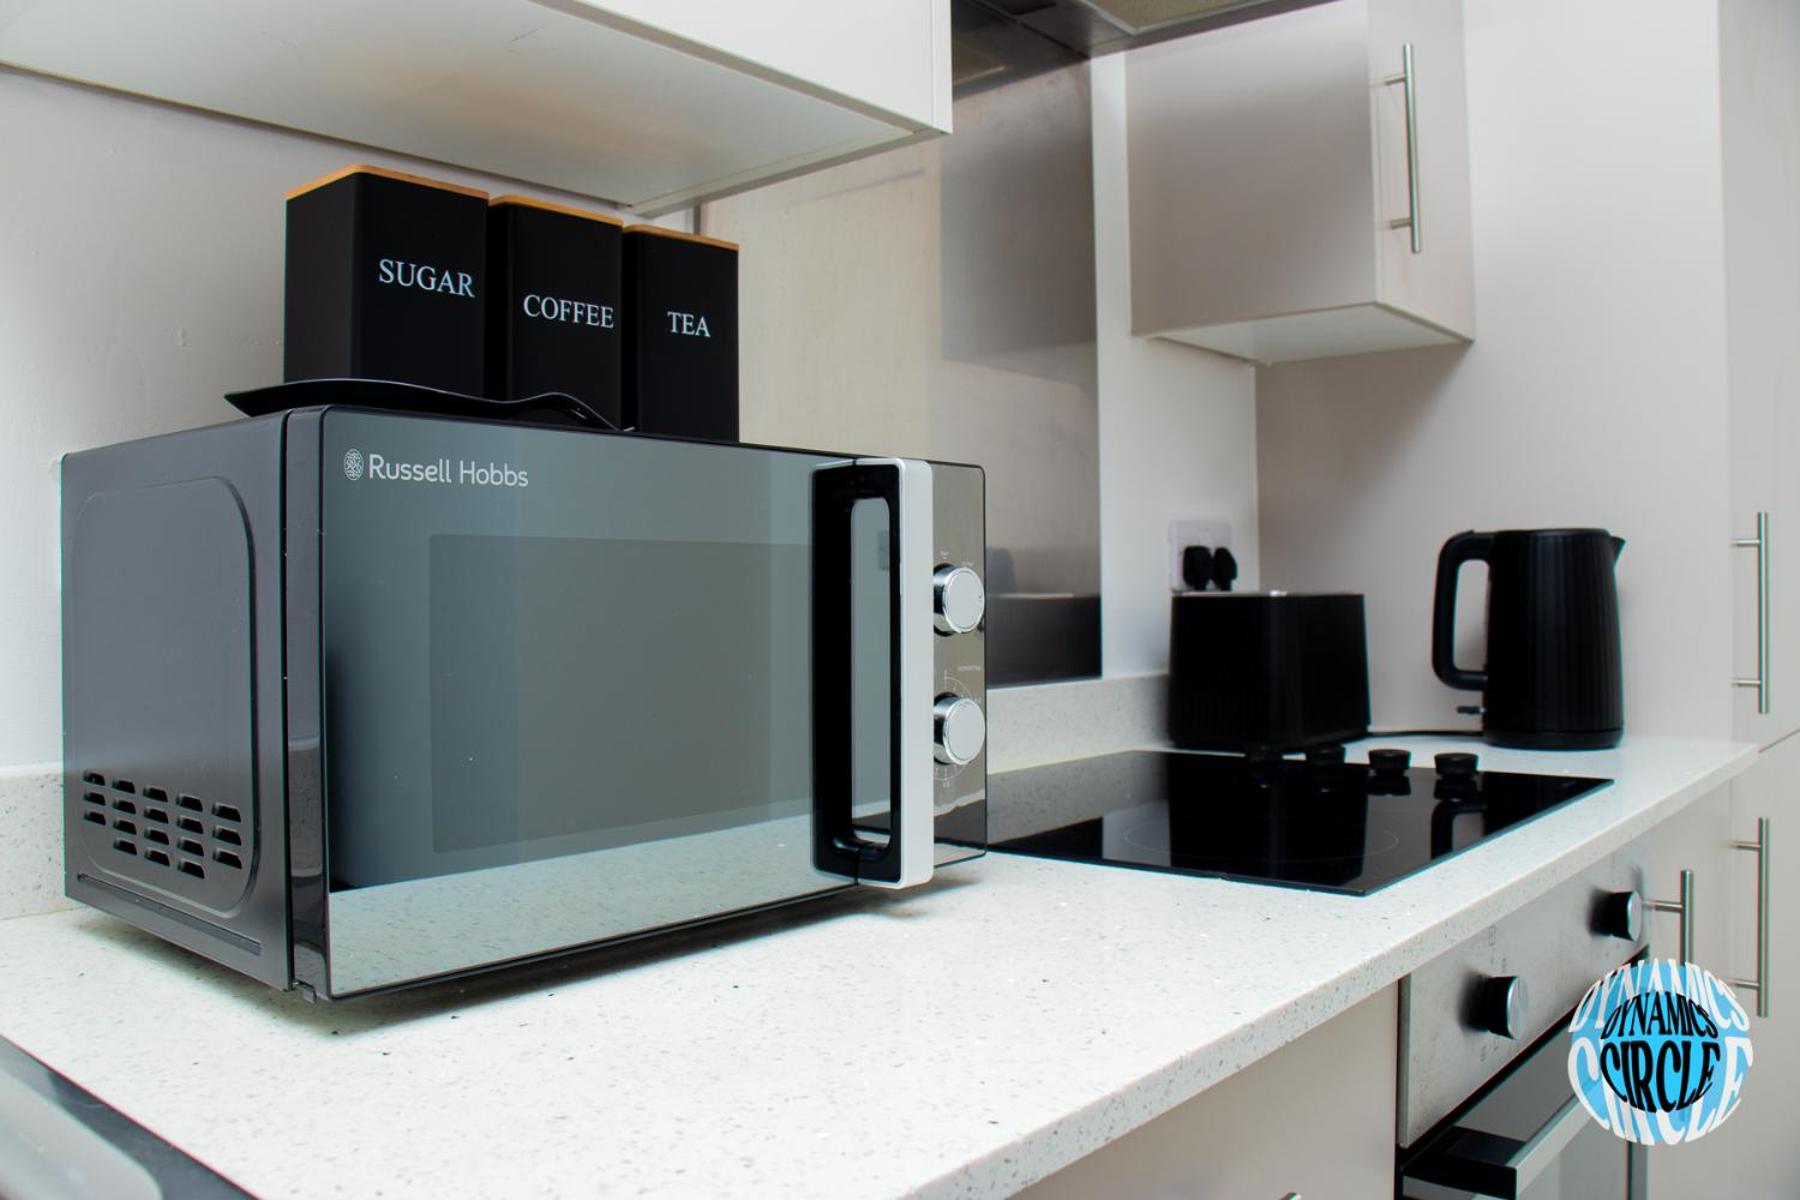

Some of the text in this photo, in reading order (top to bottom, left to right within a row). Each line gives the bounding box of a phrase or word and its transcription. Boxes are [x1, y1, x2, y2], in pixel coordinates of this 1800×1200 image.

[378, 258, 475, 298] SUGAR
[523, 294, 614, 329] COFFEE
[667, 311, 711, 338] TEA
[368, 453, 529, 487] Russell Hobbs
